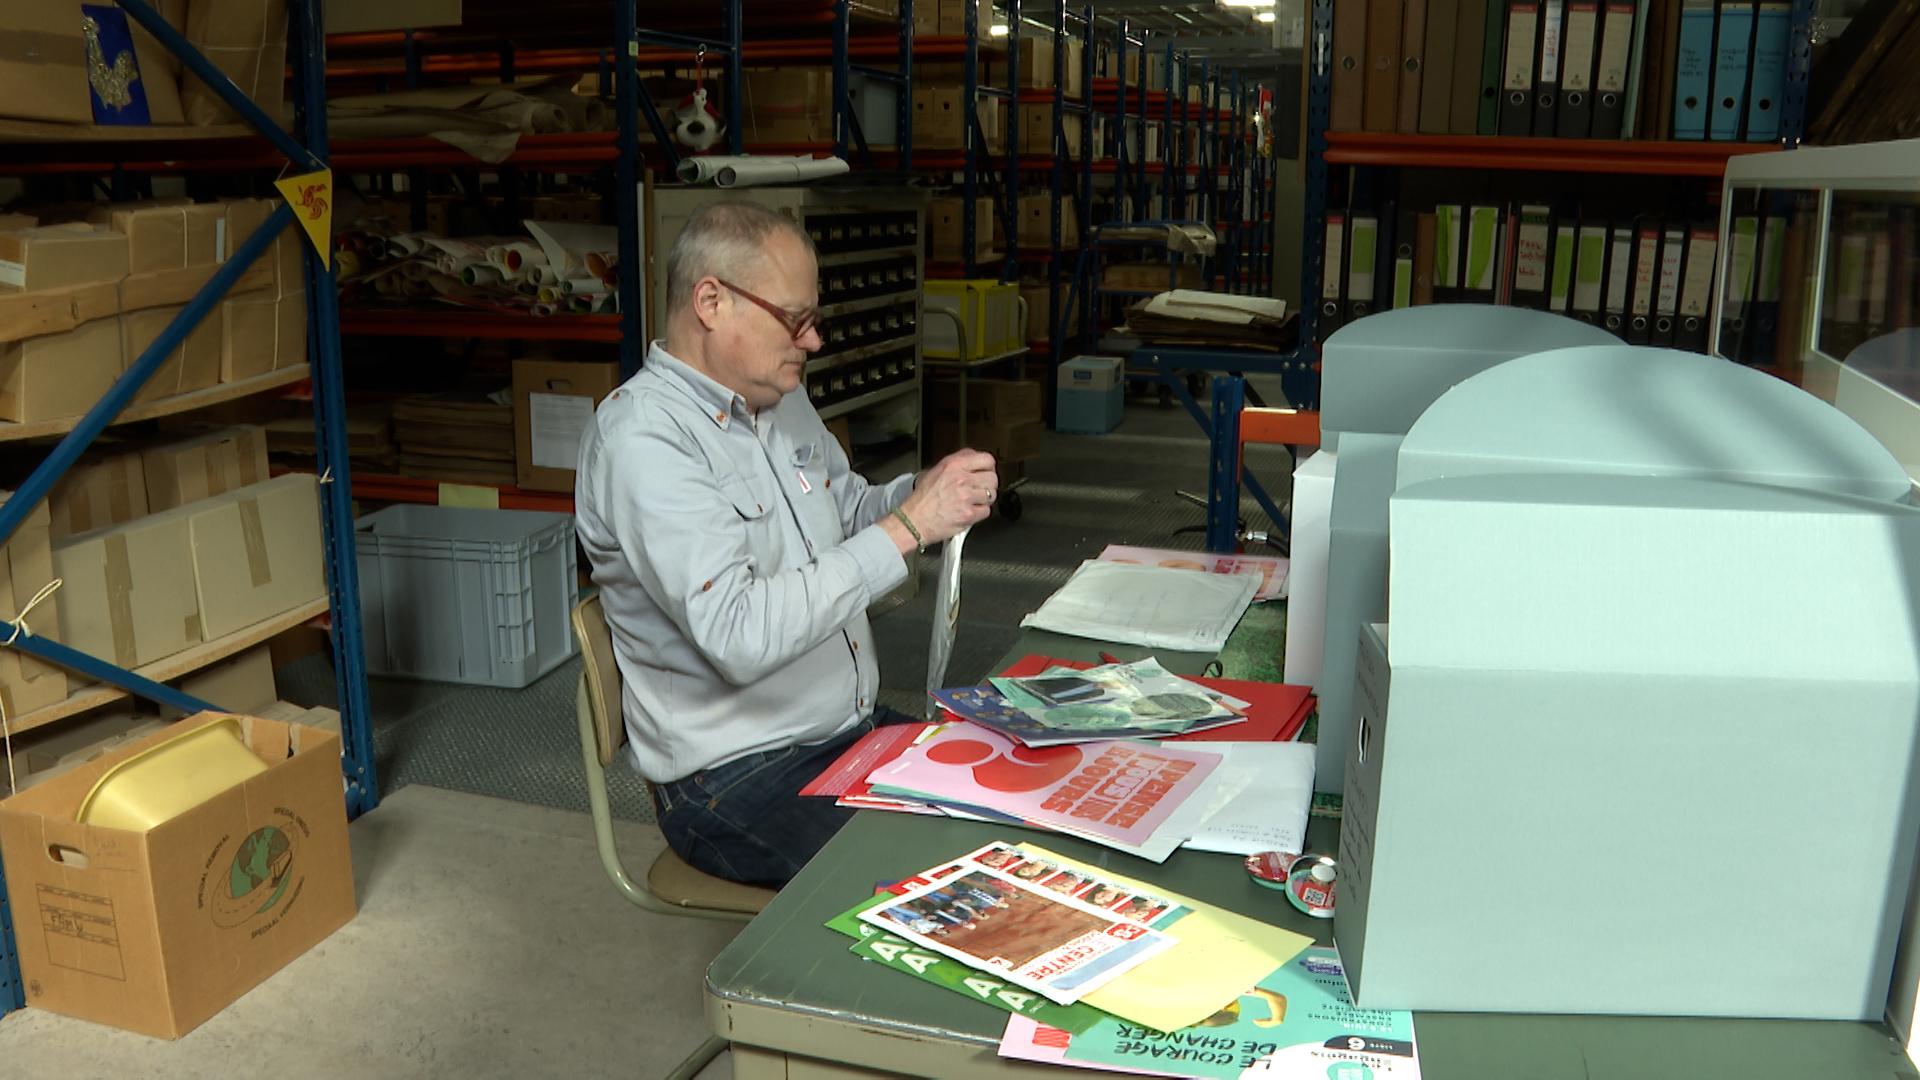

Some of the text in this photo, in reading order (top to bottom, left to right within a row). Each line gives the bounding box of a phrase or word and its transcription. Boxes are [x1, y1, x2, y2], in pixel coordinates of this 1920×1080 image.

[1026, 946, 1094, 980] CENTRE
[1116, 1023, 1278, 1056] DE CHANGER
[1348, 1037, 1366, 1051] 6
[1114, 1041, 1272, 1070] LE COURAGE
